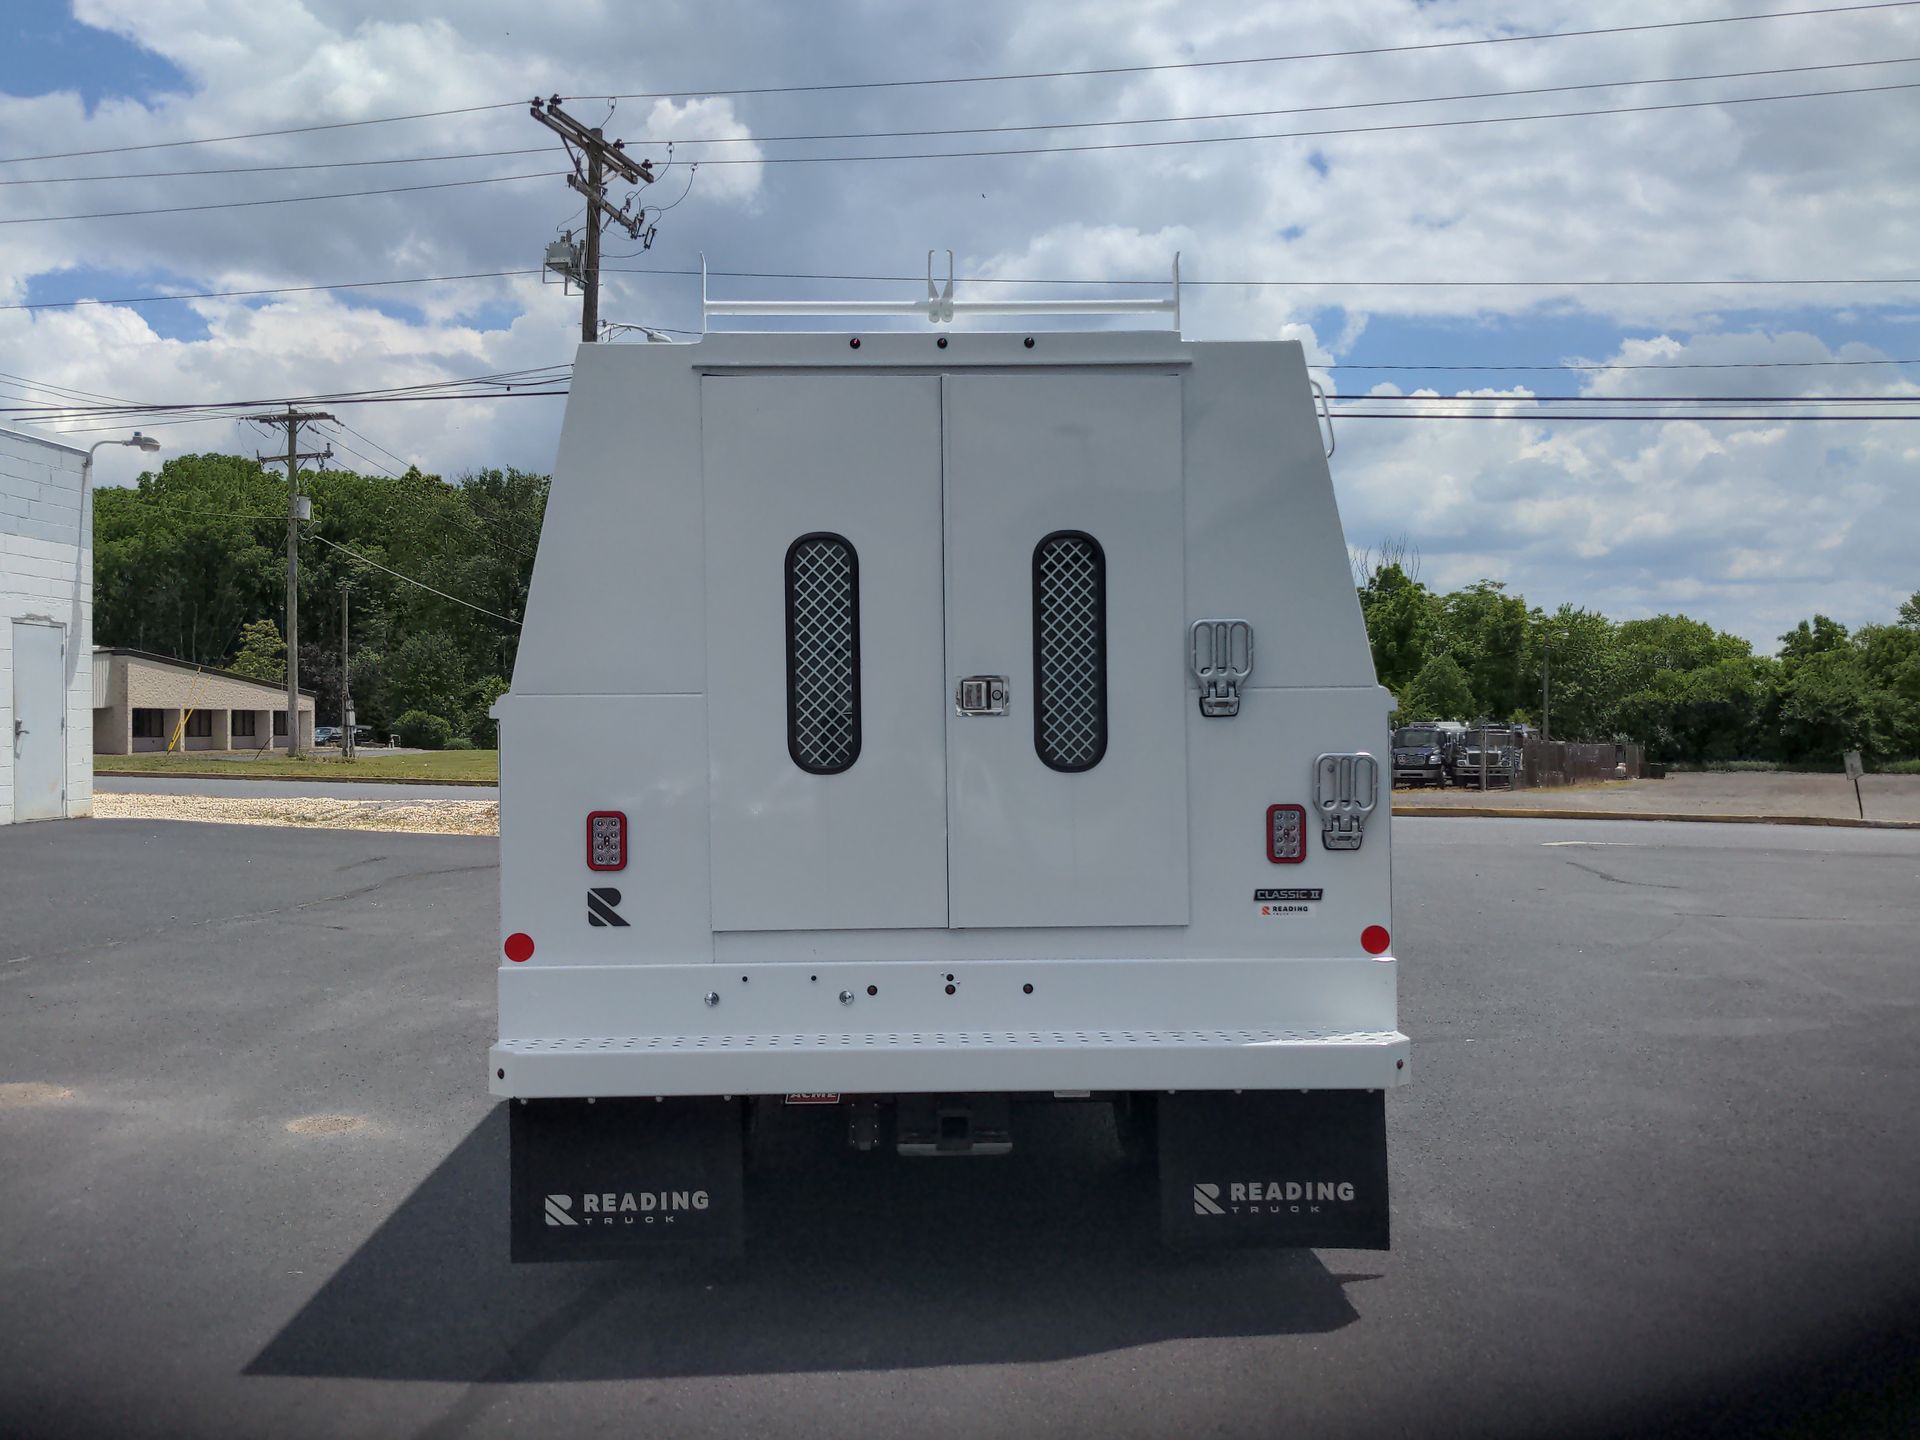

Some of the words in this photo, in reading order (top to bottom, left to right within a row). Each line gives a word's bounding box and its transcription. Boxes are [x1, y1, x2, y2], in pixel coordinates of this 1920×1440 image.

[1257, 890, 1307, 899] CLASSIC
[1230, 1181, 1355, 1201] READING
[583, 1190, 709, 1213] READING
[1231, 1205, 1321, 1214] TRUCK
[584, 1215, 675, 1225] TRUCK
